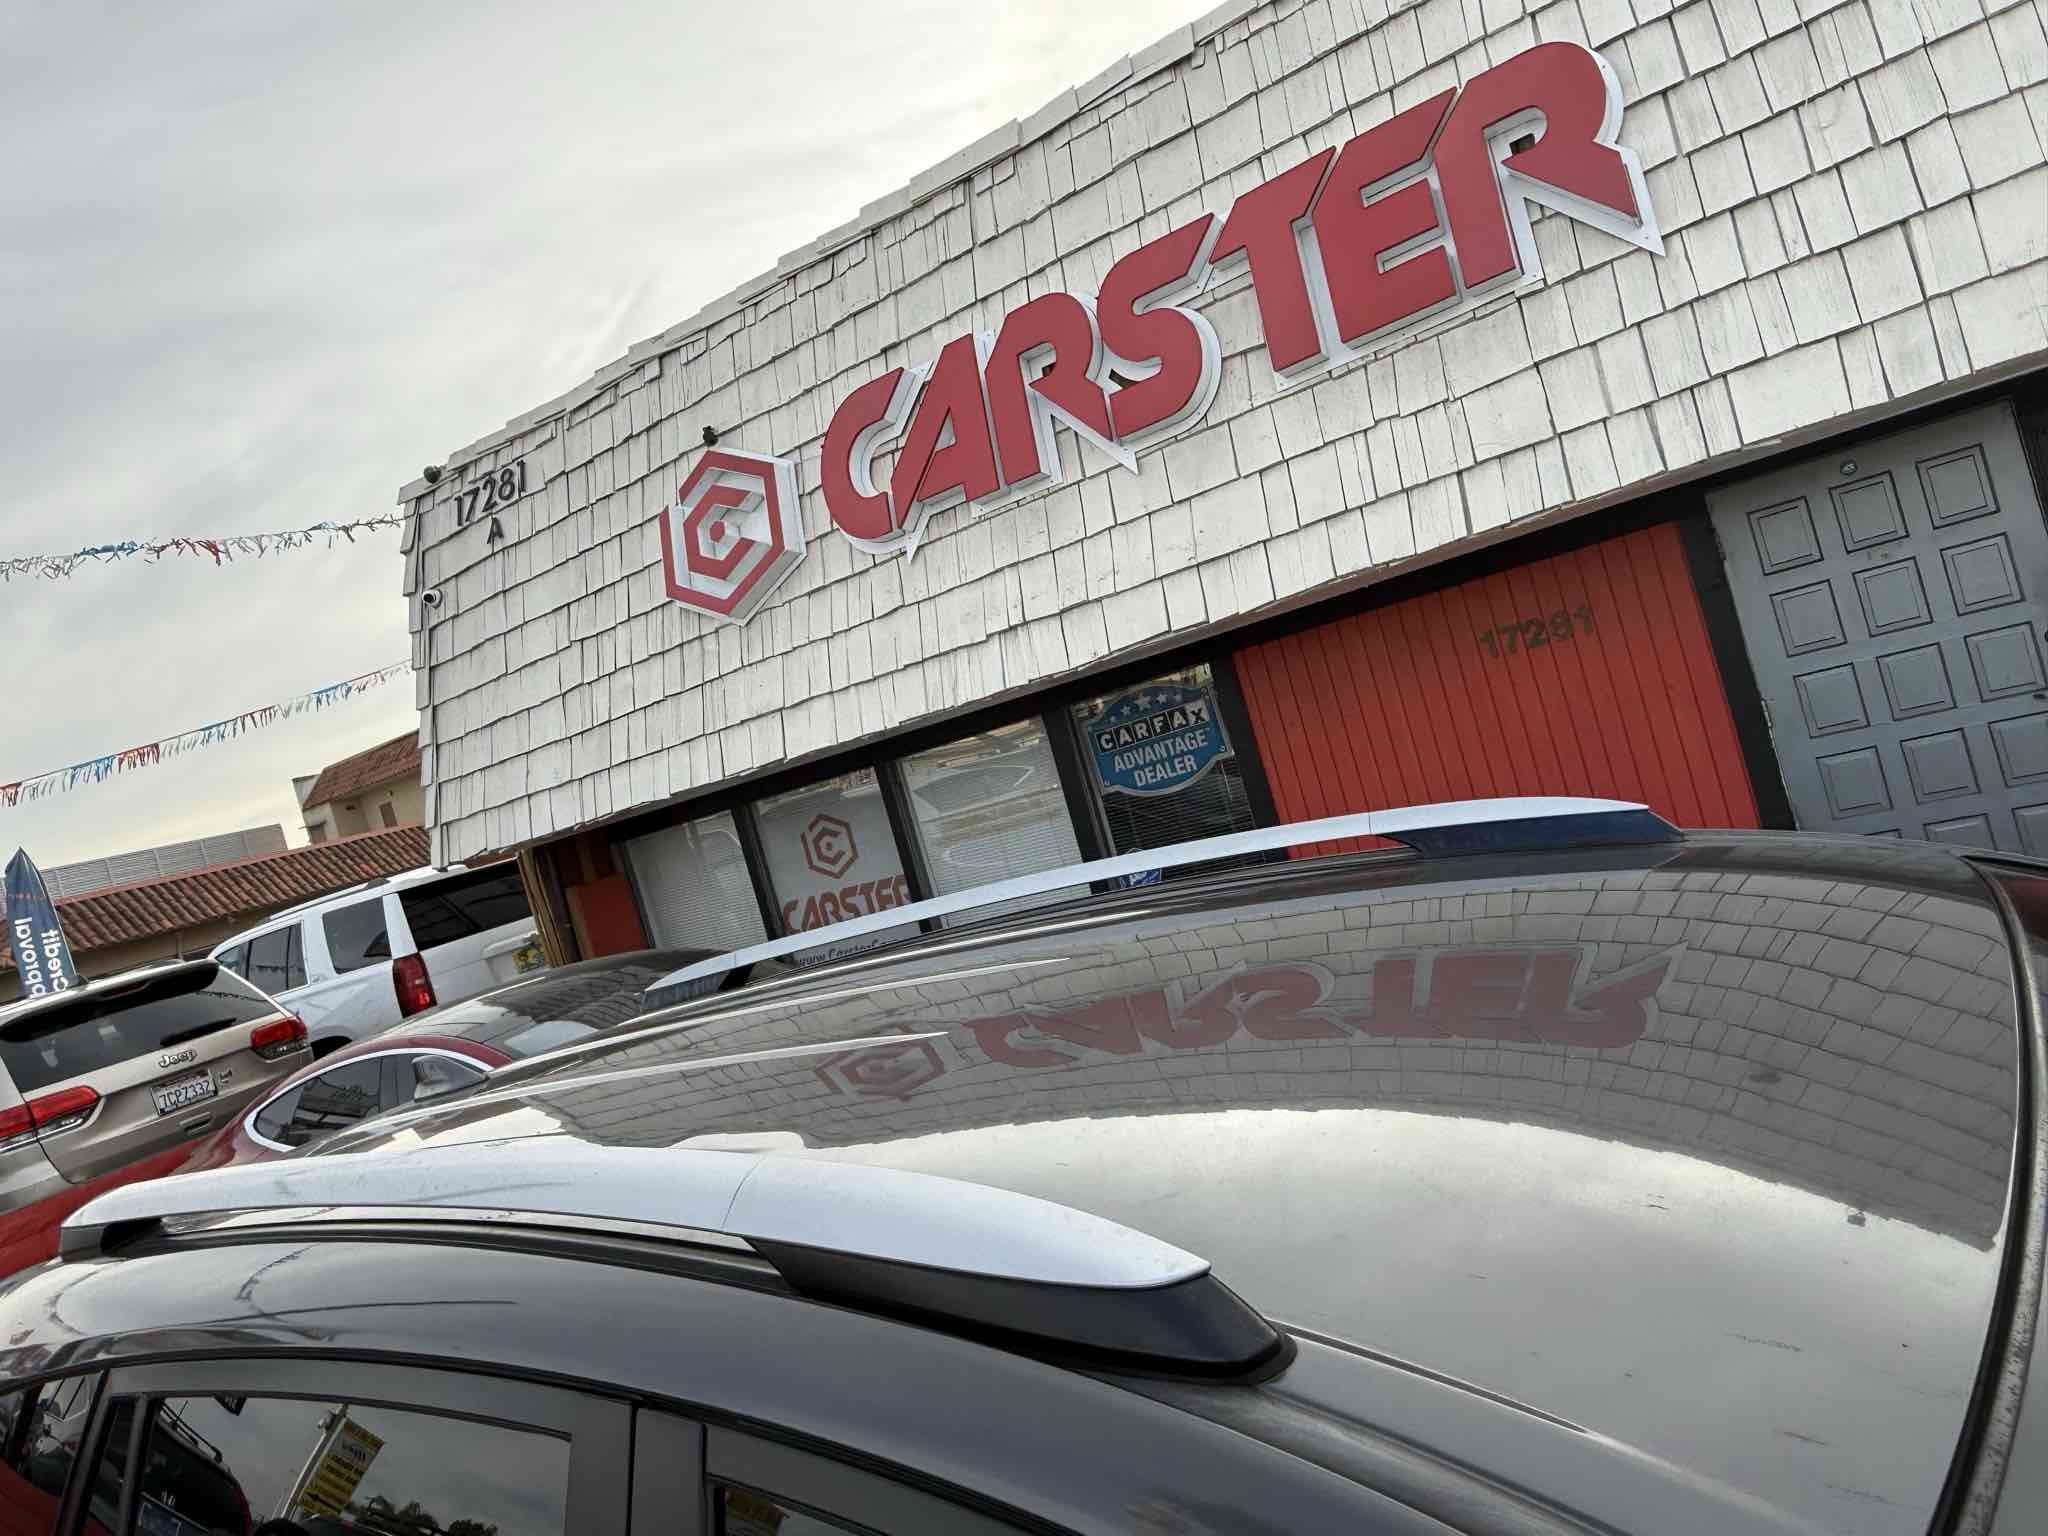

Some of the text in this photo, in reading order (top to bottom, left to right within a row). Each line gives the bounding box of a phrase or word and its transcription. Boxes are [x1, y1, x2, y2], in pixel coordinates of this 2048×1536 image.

[821, 42, 1648, 545] CARSTER
[454, 460, 526, 526] 17281
[486, 517, 504, 544] A
[1097, 703, 1210, 751] CARFAX
[1113, 731, 1210, 773] ADVANTAGE
[1133, 754, 1198, 787] DEALER
[158, 1049, 198, 1068] Jeep
